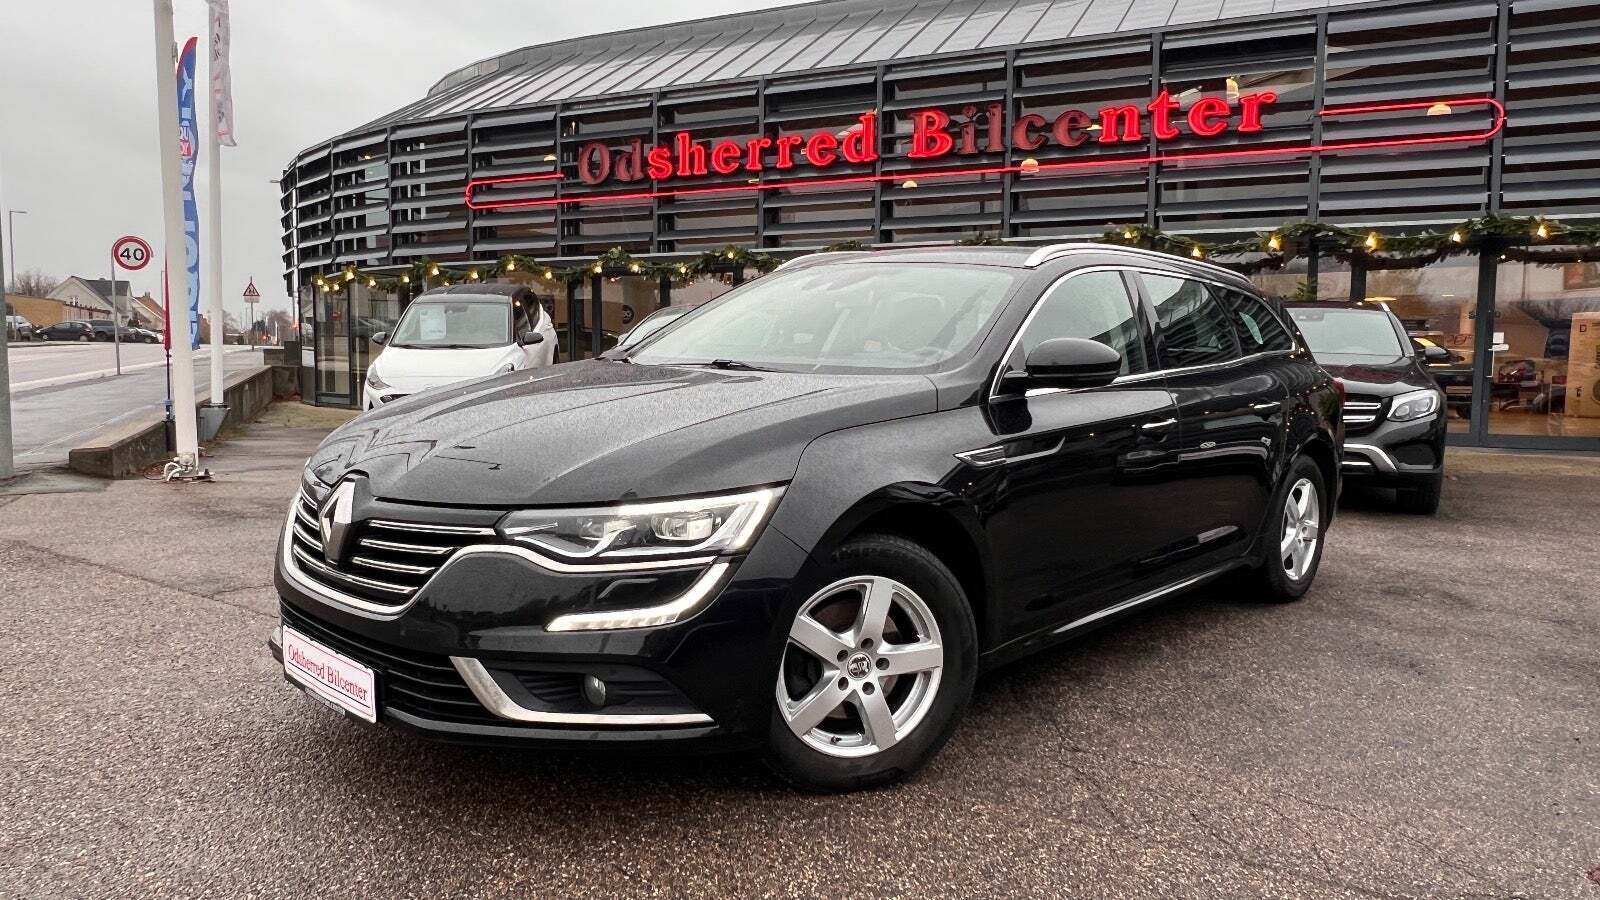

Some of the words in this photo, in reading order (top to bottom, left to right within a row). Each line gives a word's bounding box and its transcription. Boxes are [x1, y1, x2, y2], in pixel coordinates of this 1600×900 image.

[578, 110, 879, 185] Odsherred
[907, 91, 1278, 159] Bilcenter
[120, 247, 145, 261] 40
[327, 665, 367, 702] Bilcenter
